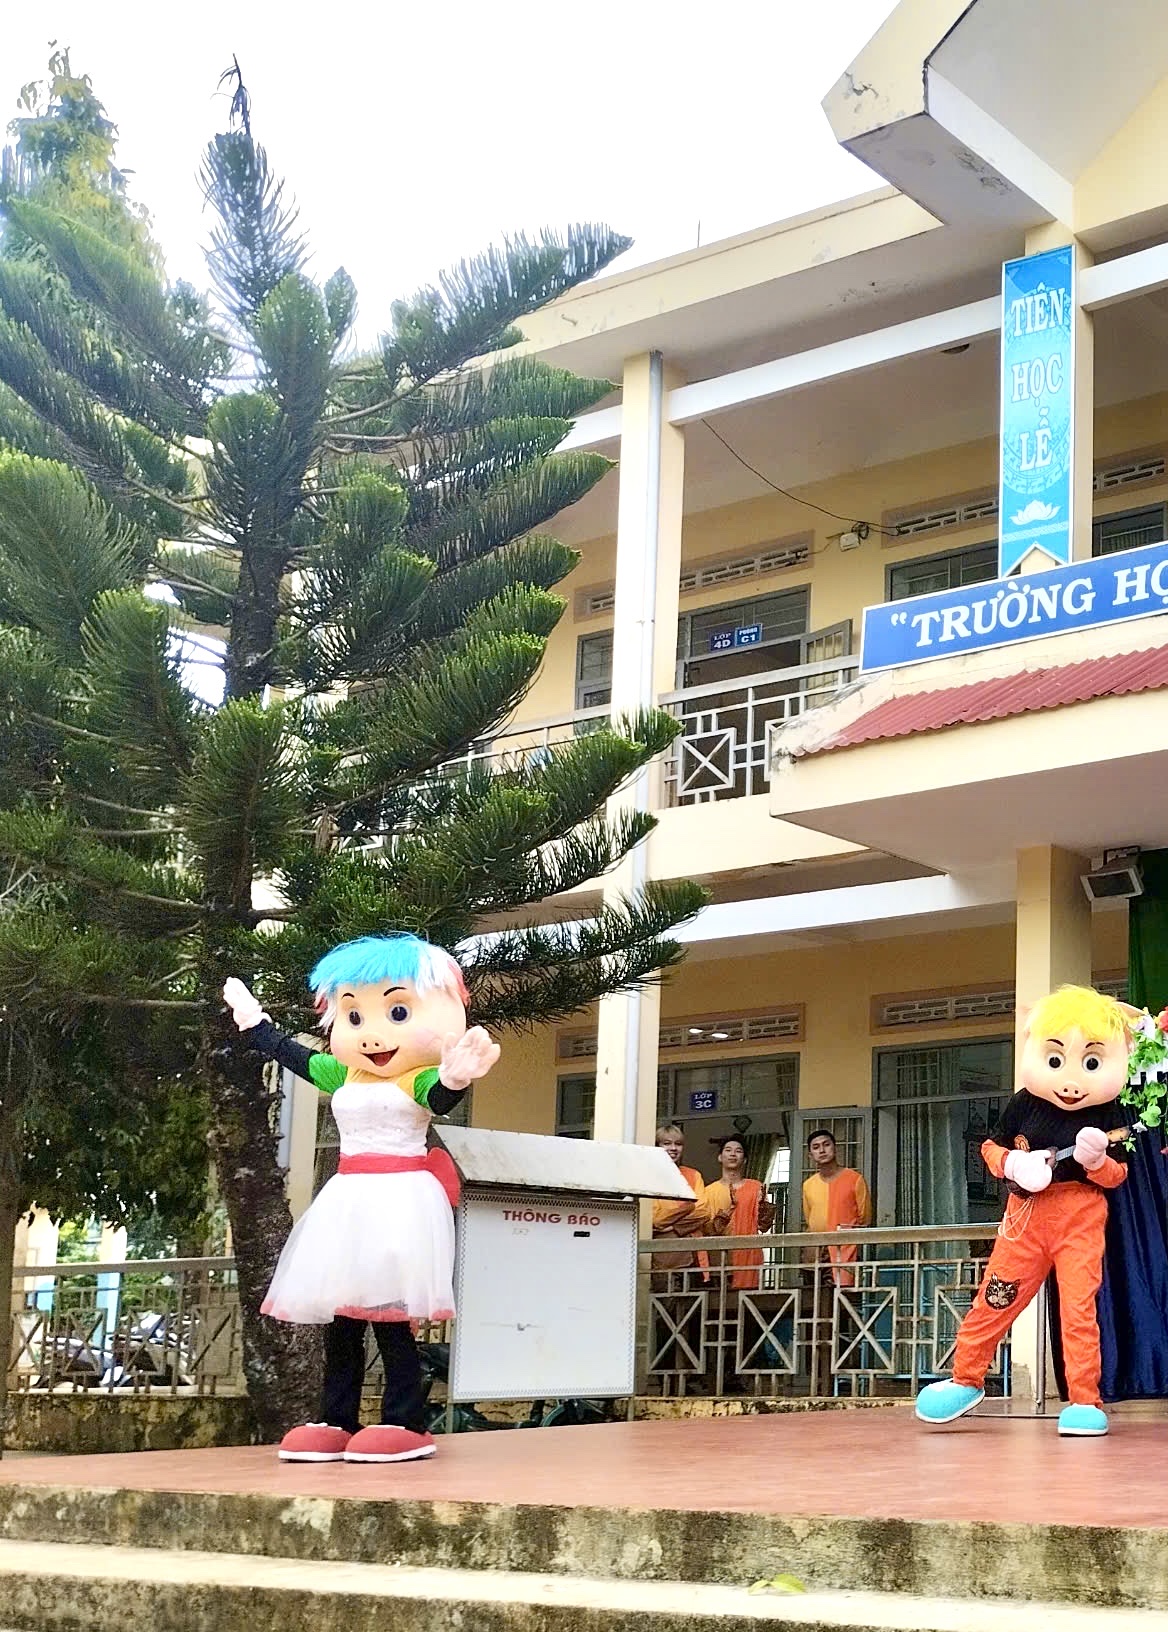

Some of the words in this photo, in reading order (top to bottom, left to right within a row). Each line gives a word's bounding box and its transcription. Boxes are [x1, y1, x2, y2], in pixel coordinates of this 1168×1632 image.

[1011, 282, 1066, 337] TIÊN
[1011, 353, 1063, 407] HỌC
[713, 639, 731, 649] 4D
[741, 634, 756, 643] C1
[695, 1099, 712, 1109] 3C
[502, 1208, 562, 1224] THÔNG
[567, 1213, 601, 1226] BÁO
